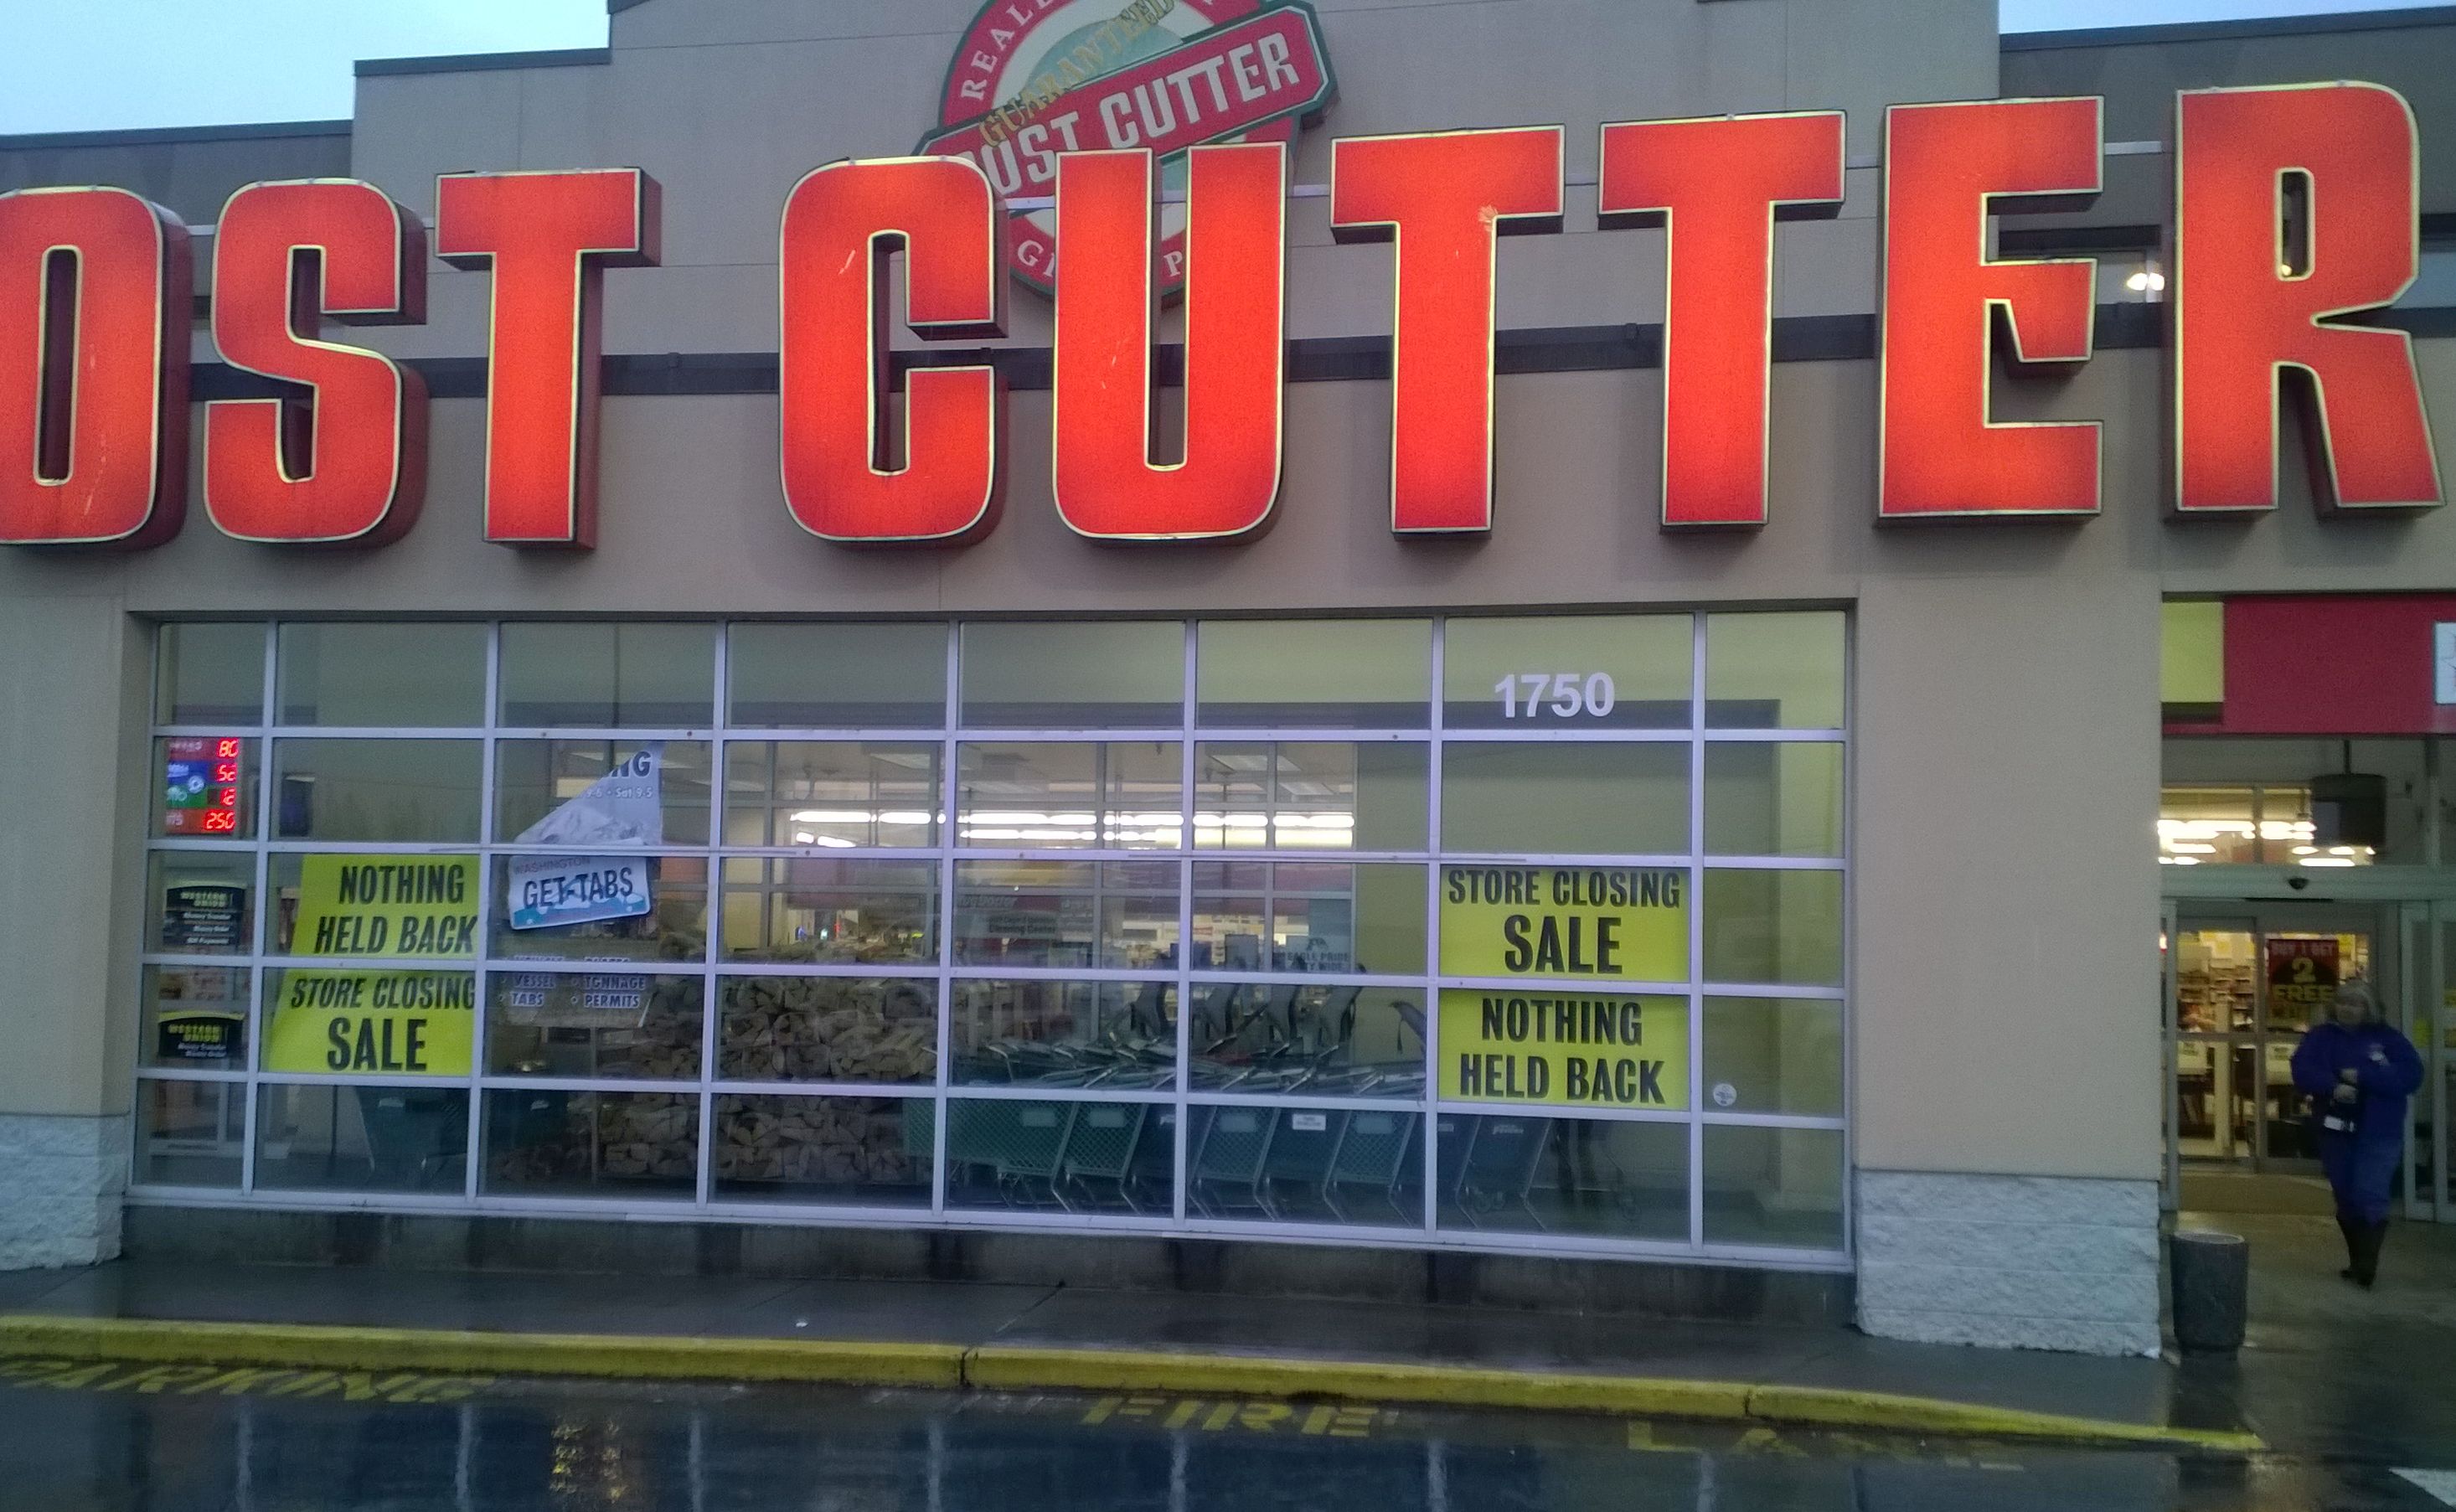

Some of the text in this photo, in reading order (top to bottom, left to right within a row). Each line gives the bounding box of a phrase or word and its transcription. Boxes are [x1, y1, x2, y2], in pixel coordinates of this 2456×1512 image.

[959, 0, 1054, 101] REAL
[978, 0, 1176, 148] GUARANTEED
[960, 31, 1301, 196] OST CUTTER
[0, 80, 2449, 550] OST CUTTER
[1494, 672, 1616, 719] 1750
[338, 864, 465, 905] NOTHING
[1447, 869, 1681, 909] STORE CLOSING
[314, 914, 479, 955] HELD BACK
[1503, 913, 1623, 974] SALE
[290, 977, 476, 1011] STORE CLOSING
[2291, 957, 2317, 984] 2
[510, 991, 641, 1009] TABS PERMITS
[1481, 997, 1643, 1047] NOTHING
[327, 1017, 429, 1072] SALE
[1459, 1053, 1666, 1105] HELD BACK
